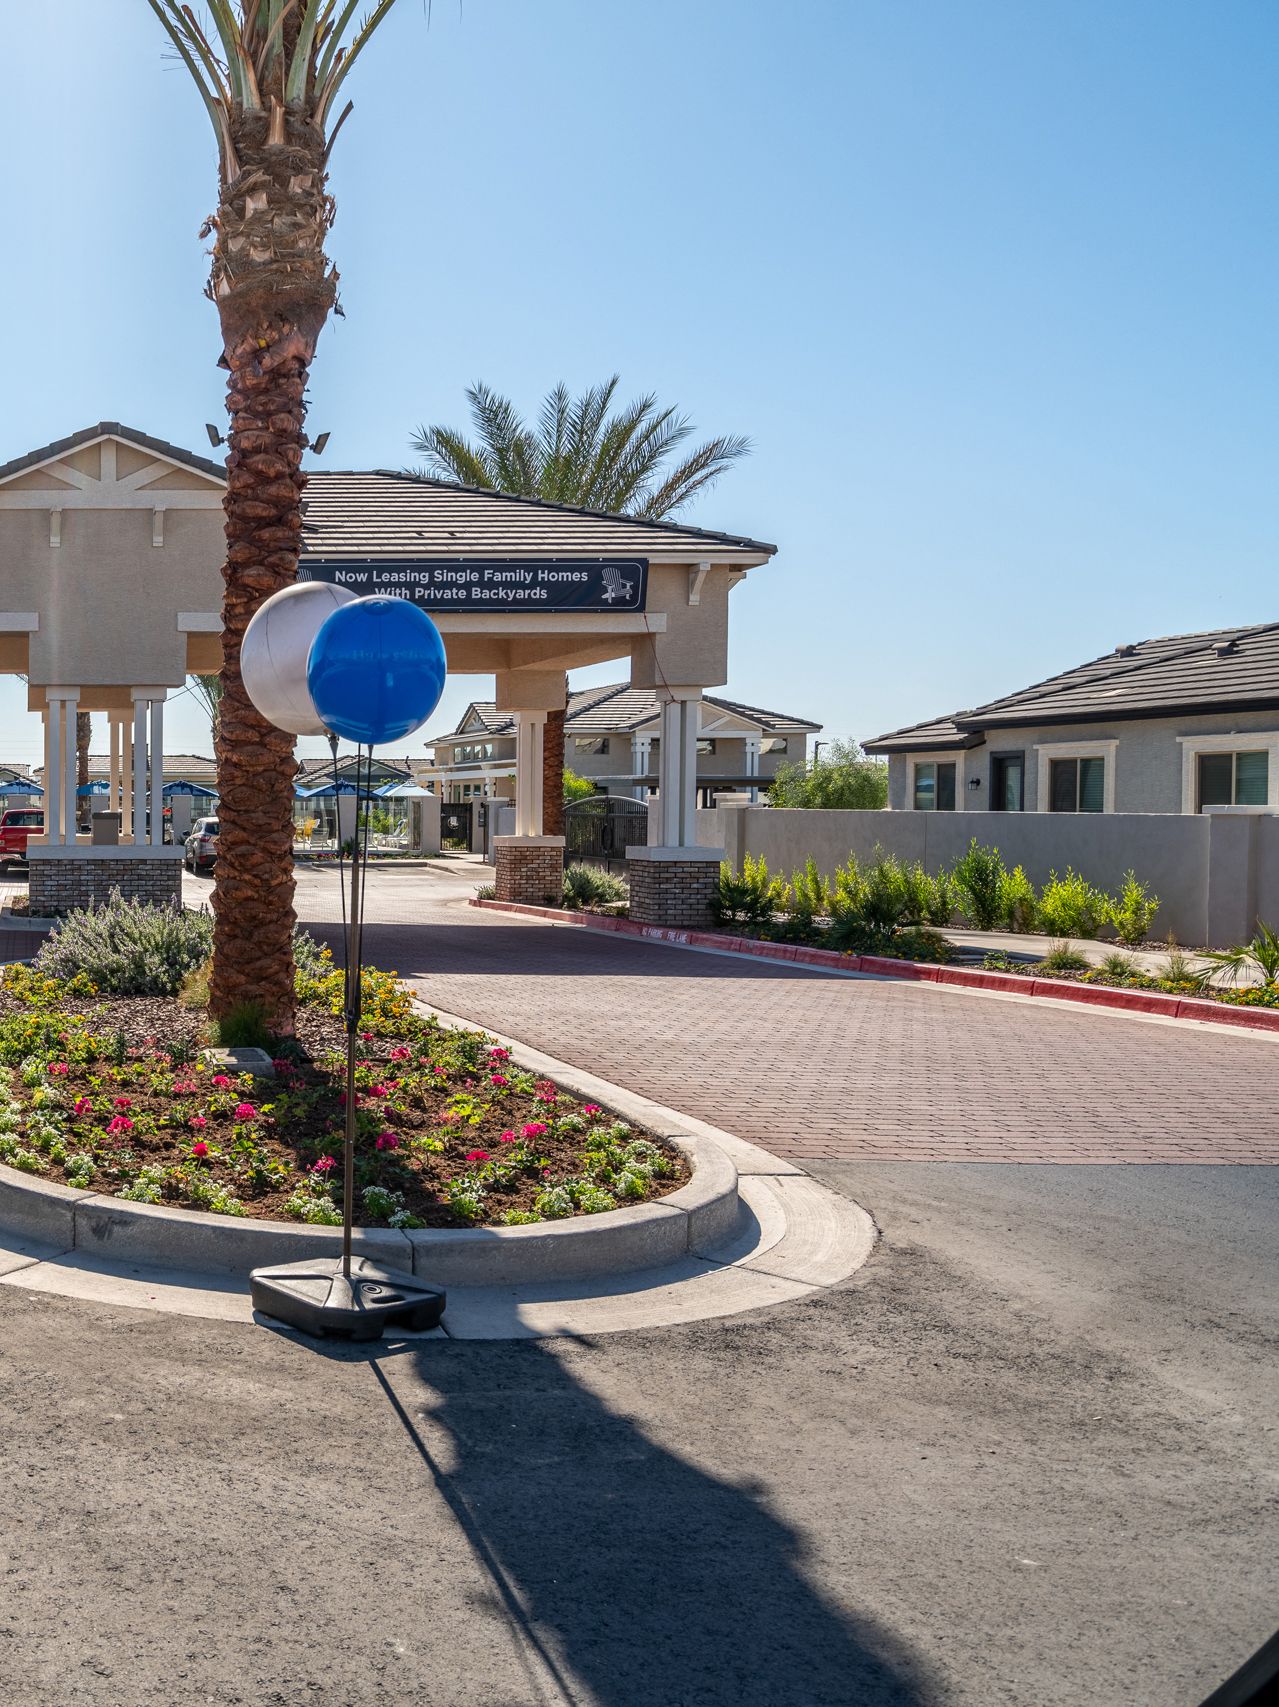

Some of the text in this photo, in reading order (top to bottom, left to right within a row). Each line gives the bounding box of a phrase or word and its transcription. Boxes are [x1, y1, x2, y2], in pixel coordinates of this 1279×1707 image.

[335, 569, 588, 584] Now Leasing Single Family Homes
[415, 587, 467, 599] Private
[471, 586, 548, 601] Backyards
